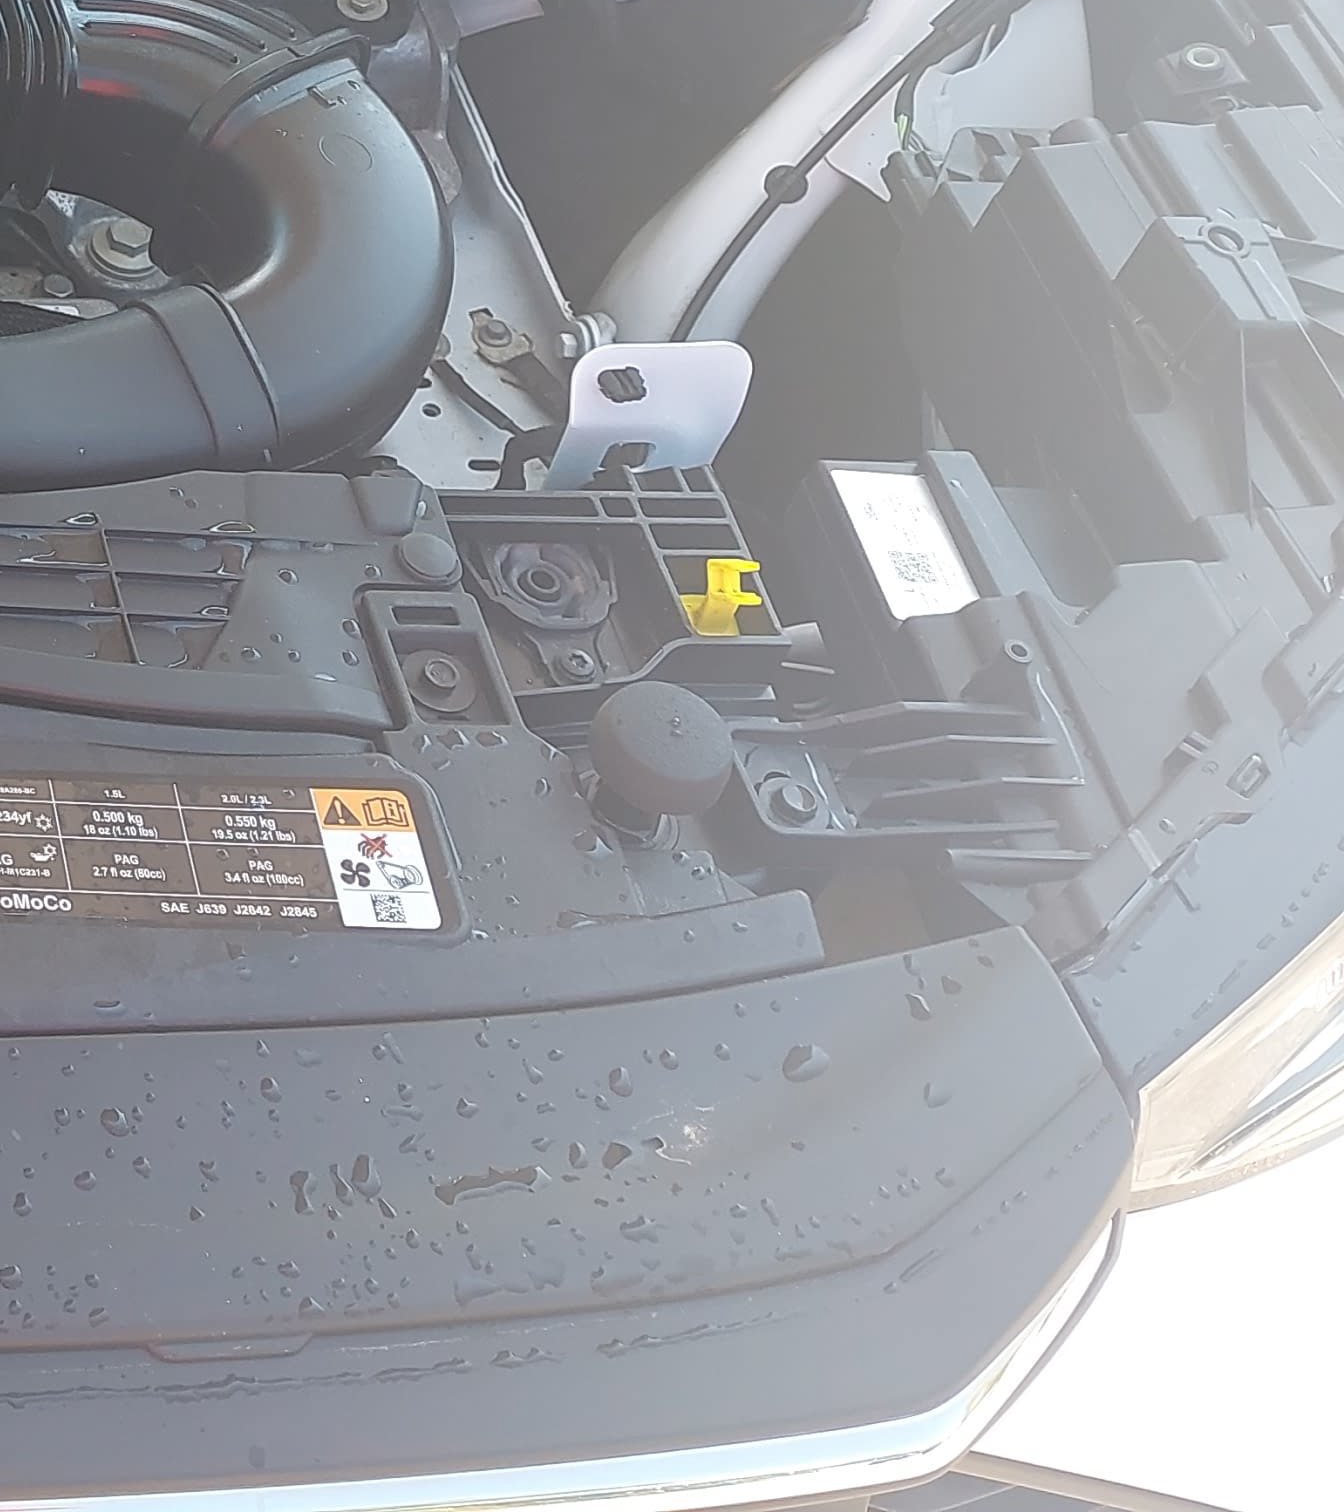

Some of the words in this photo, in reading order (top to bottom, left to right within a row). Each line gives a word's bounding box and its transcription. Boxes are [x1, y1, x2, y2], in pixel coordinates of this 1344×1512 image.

[103, 789, 126, 799] 1.5L
[220, 794, 244, 804] 2.0L
[92, 810, 125, 823] 0.500
[127, 811, 144, 827] kg
[224, 815, 257, 827] 0.550
[259, 816, 276, 830] kg
[83, 824, 96, 835] 18
[97, 826, 111, 836] oz
[112, 825, 137, 837] (1.10
[139, 826, 159, 839] lbs)
[211, 829, 234, 840] 19.5
[235, 831, 248, 841] oz
[249, 830, 274, 842] (1.21
[276, 830, 296, 843] lbs)
[113, 853, 140, 865] PAG
[247, 860, 273, 871] PAG
[92, 866, 108, 878] 2.7
[109, 866, 118, 878] fl
[120, 869, 133, 879] oz
[224, 872, 241, 883] 3.4
[252, 874, 265, 884] oz
[266, 873, 304, 887] (100cc)
[160, 902, 190, 913] SAE
[195, 903, 227, 915] J639
[233, 904, 272, 916] J2842
[279, 905, 318, 918] J2845
